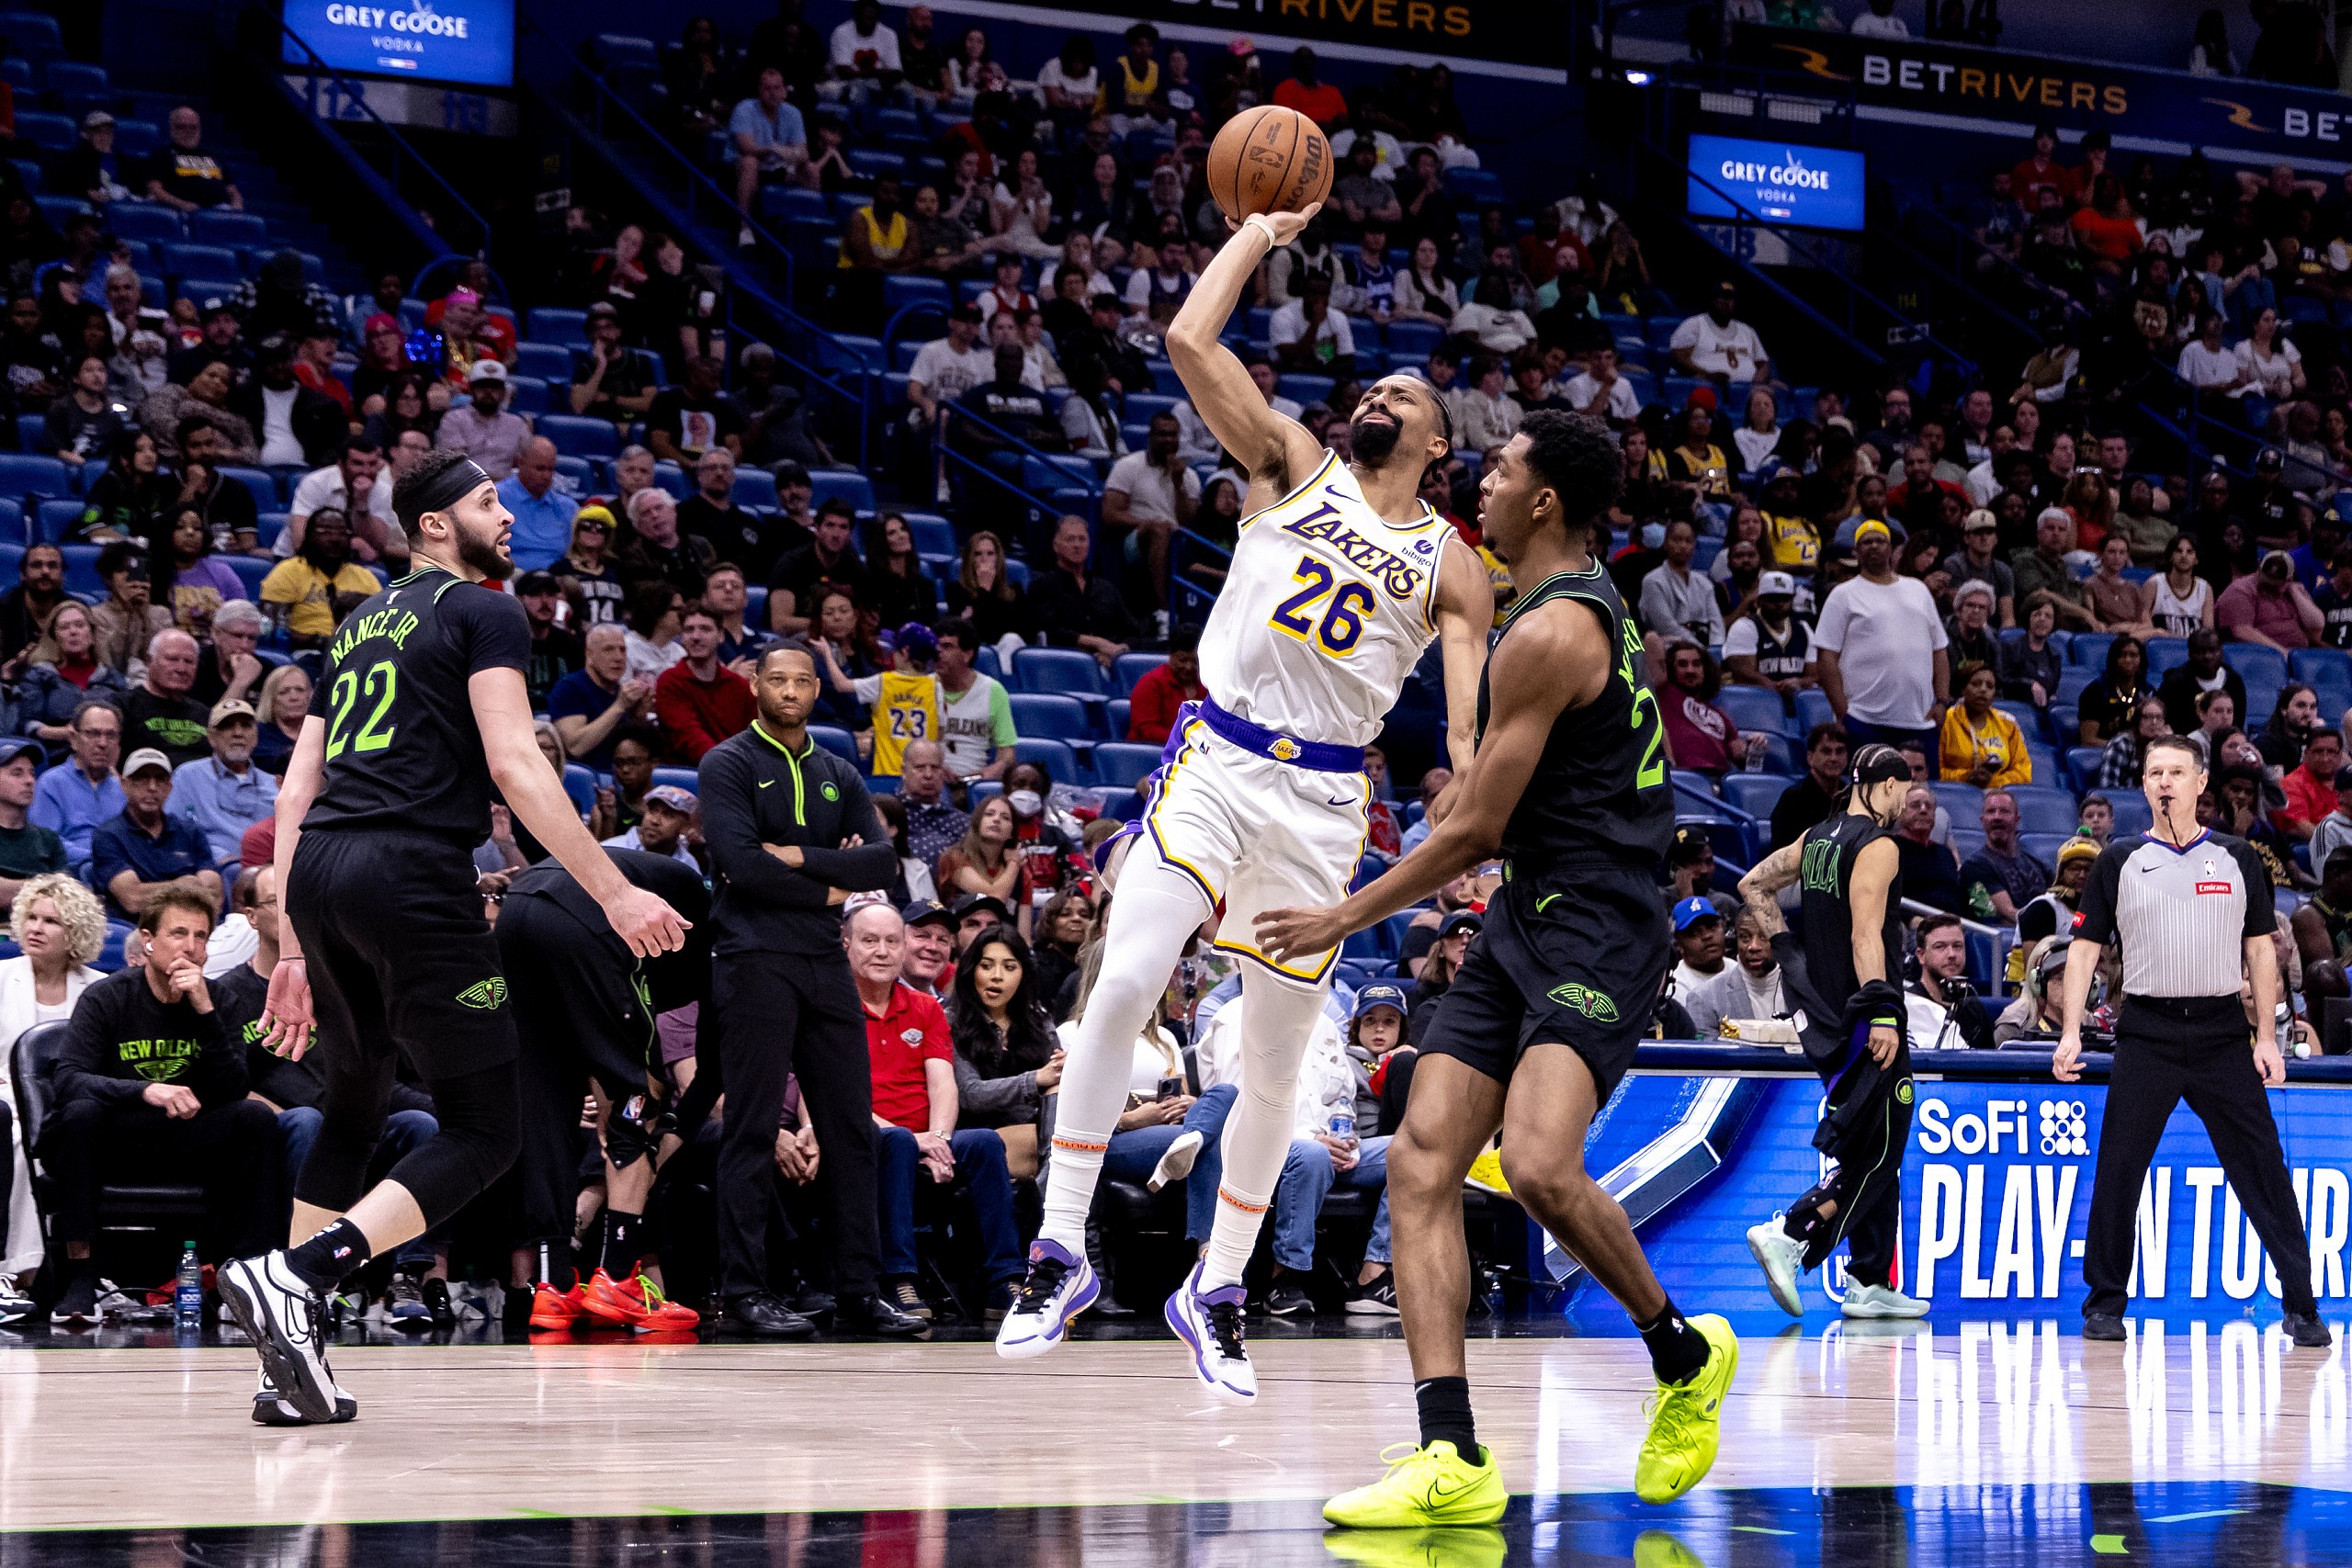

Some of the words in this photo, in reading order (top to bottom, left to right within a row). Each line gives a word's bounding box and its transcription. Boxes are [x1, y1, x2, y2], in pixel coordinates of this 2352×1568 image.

[325, 3, 386, 28] GREY
[390, 10, 469, 39] GOOSE
[1170, 0, 1471, 36] RIVERS
[370, 35, 424, 52] VODKA
[1863, 54, 2128, 115] BETRIVERS
[2284, 107, 2352, 141] BE
[1722, 160, 1767, 183] GREY
[1770, 165, 1830, 190] GOOSE
[1756, 187, 1796, 204] VODKA
[1282, 501, 1426, 603] LAKERS
[1401, 547, 1431, 568] bibigo
[1267, 553, 1379, 659] 26
[330, 608, 399, 669] NANCE
[388, 610, 419, 651] JR.
[325, 658, 399, 764] 22
[889, 706, 927, 739] 23
[1631, 687, 1664, 790] 2
[1802, 840, 1841, 898] NOLA
[2199, 884, 2229, 892] Emirates
[119, 1040, 152, 1061] NEW
[1917, 1099, 2028, 1155] SoFi
[1915, 1164, 2172, 1298] PLAY-N
